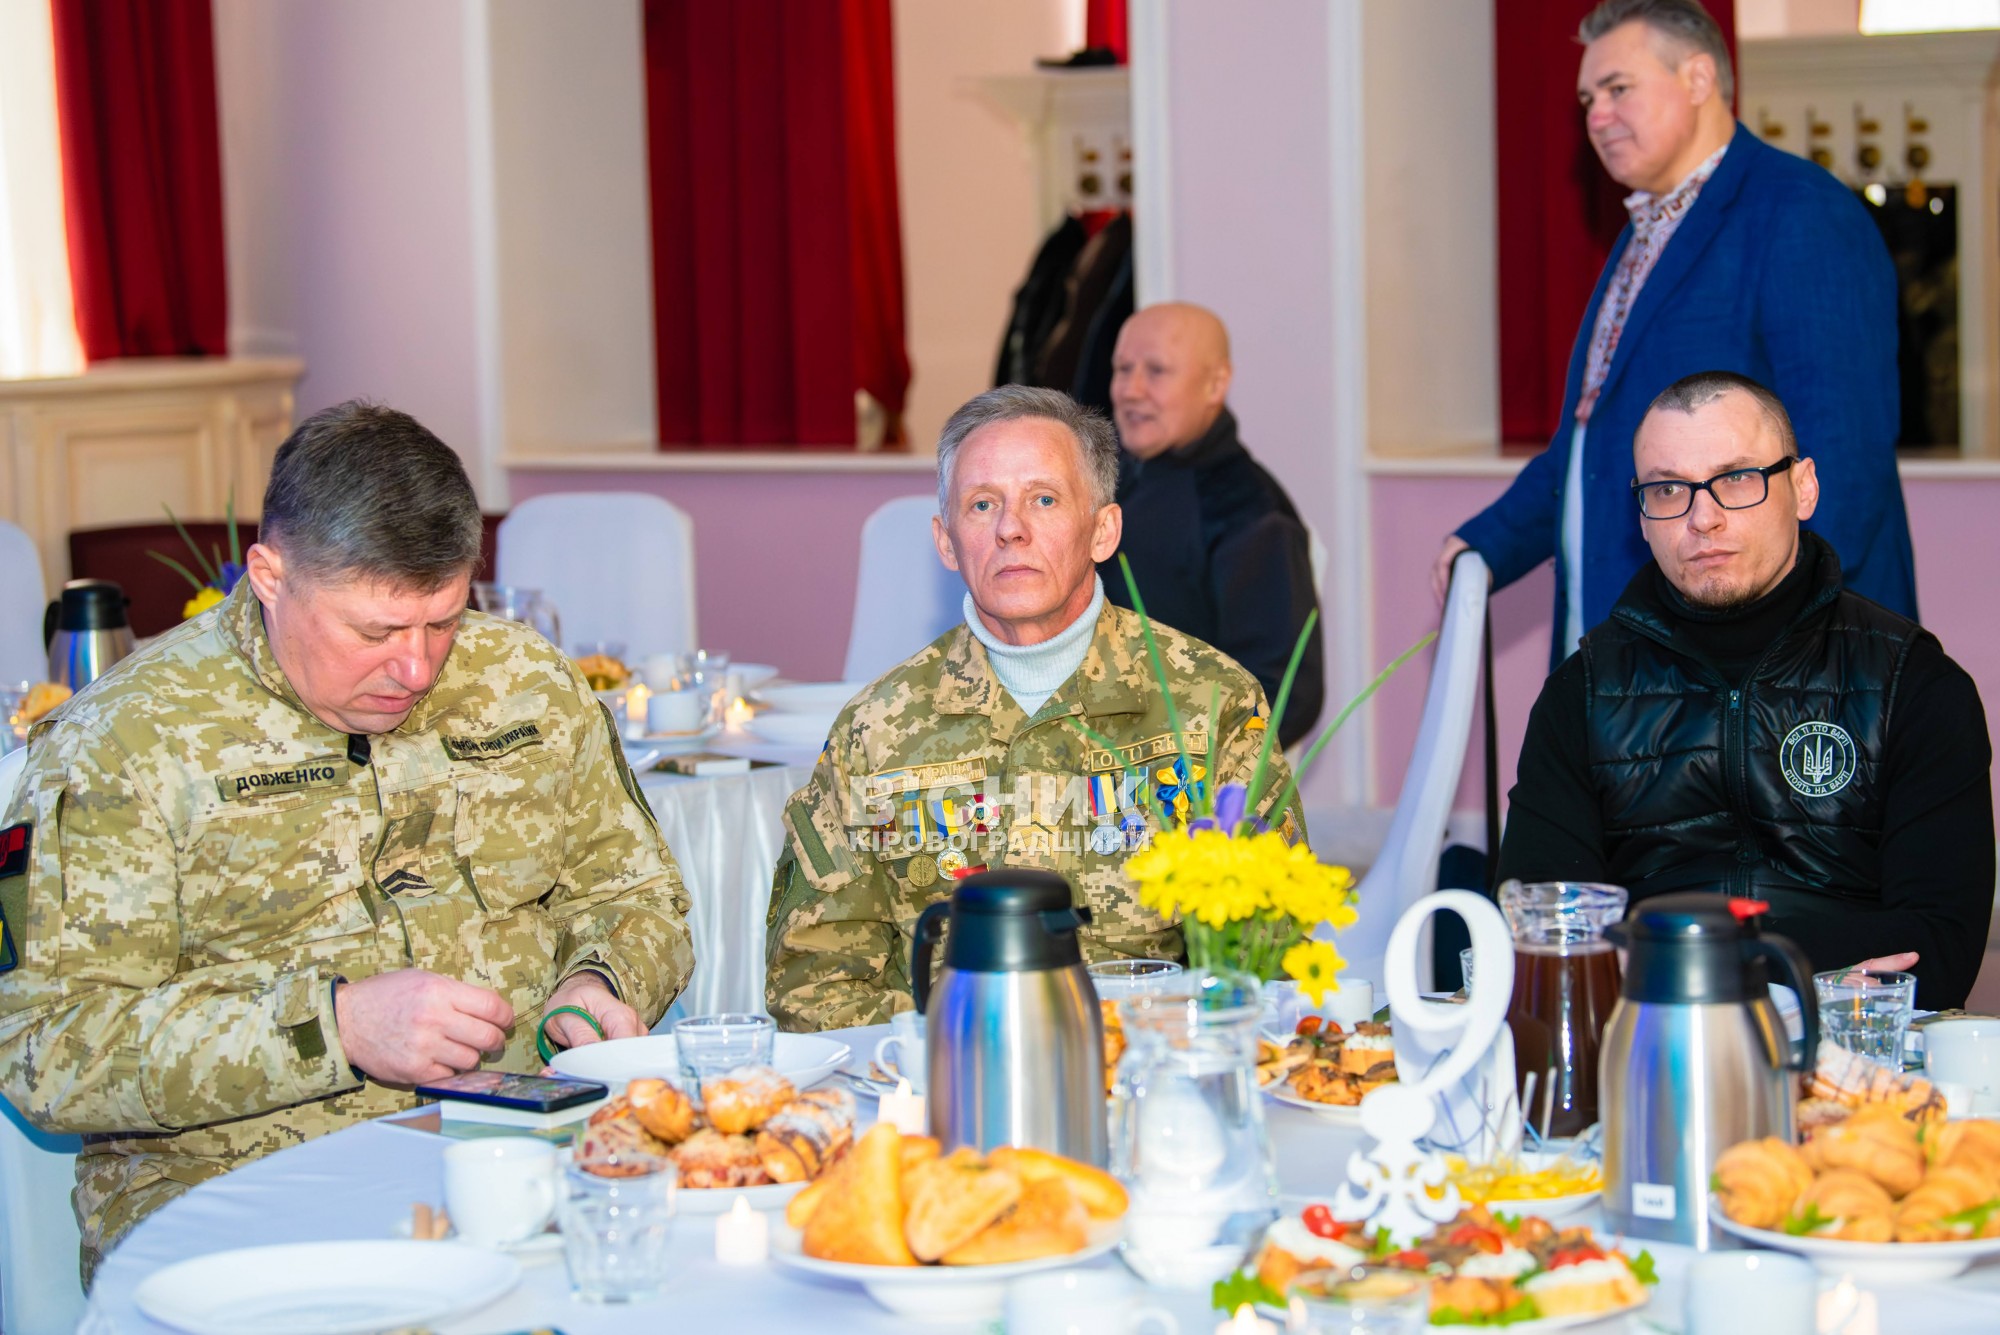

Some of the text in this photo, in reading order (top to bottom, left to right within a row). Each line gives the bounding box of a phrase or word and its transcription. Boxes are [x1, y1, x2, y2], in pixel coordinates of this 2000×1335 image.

[501, 724, 540, 745] УКРАЇНИ
[1151, 736, 1176, 754] Rh
[1788, 725, 1850, 747] ВСІ ТІ ХТО ВАРТІ
[236, 766, 335, 793] ДОВЖЕНКО
[914, 763, 970, 779] УКРАЇНА
[1785, 769, 1811, 793] СТОЯТЬ
[1829, 770, 1850, 790] ВАРТІ
